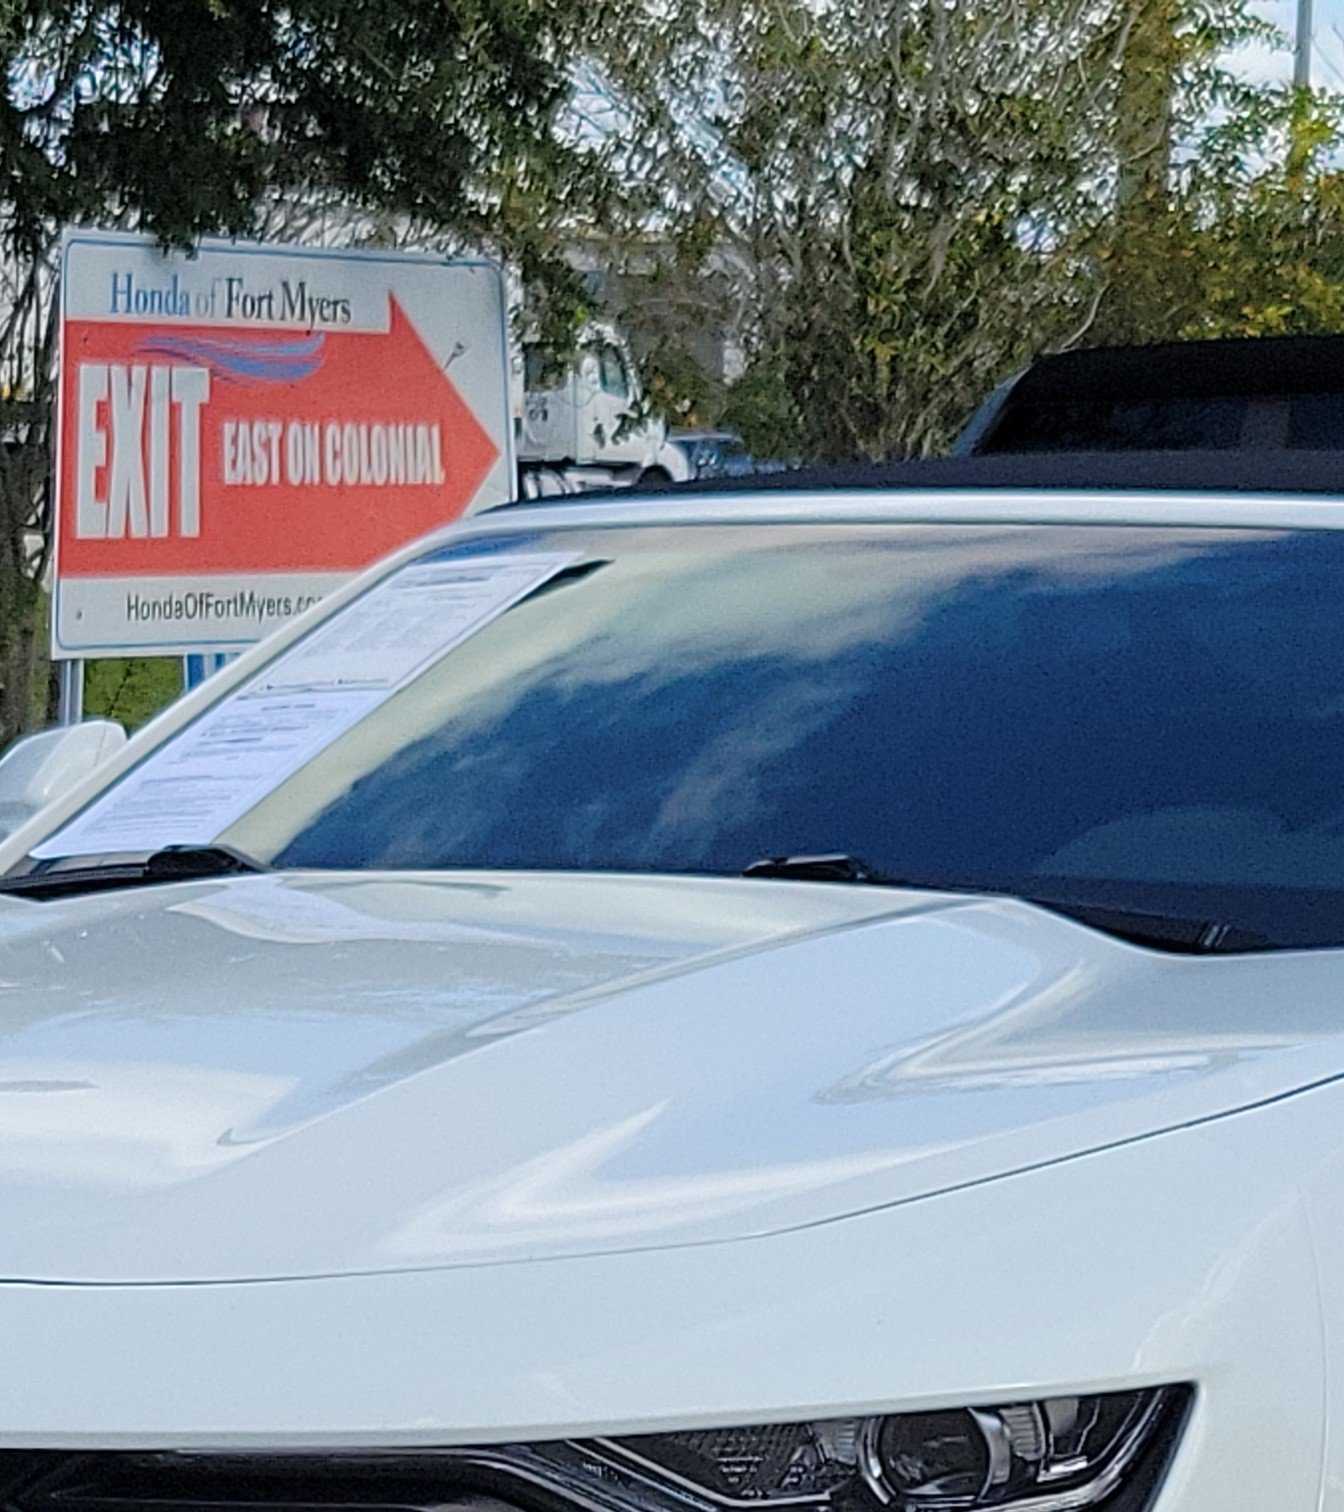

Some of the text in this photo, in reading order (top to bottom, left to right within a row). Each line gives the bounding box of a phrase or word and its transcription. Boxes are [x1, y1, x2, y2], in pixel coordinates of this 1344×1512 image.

[109, 271, 352, 328] Honda of Fort Myers
[75, 364, 211, 540] EXIT
[223, 420, 446, 486] EAST ON COLONIAL
[126, 591, 324, 624] HondaOfFortMyers.co
